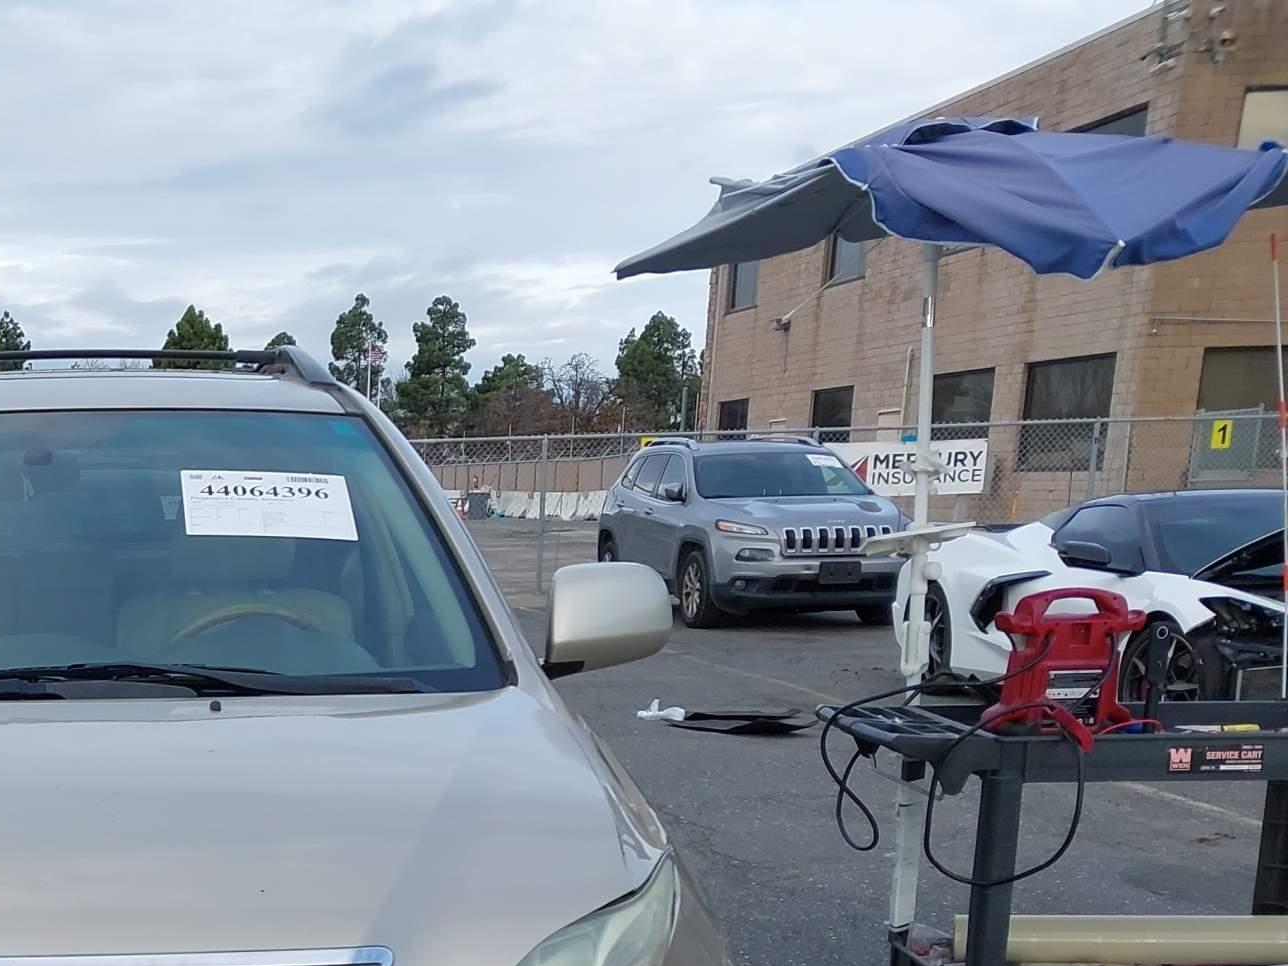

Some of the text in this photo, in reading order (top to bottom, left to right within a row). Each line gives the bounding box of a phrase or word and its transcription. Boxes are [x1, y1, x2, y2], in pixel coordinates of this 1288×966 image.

[1217, 423, 1228, 445] 1
[200, 484, 329, 500] 44064396
[1206, 750, 1263, 760] SERVICE CART
